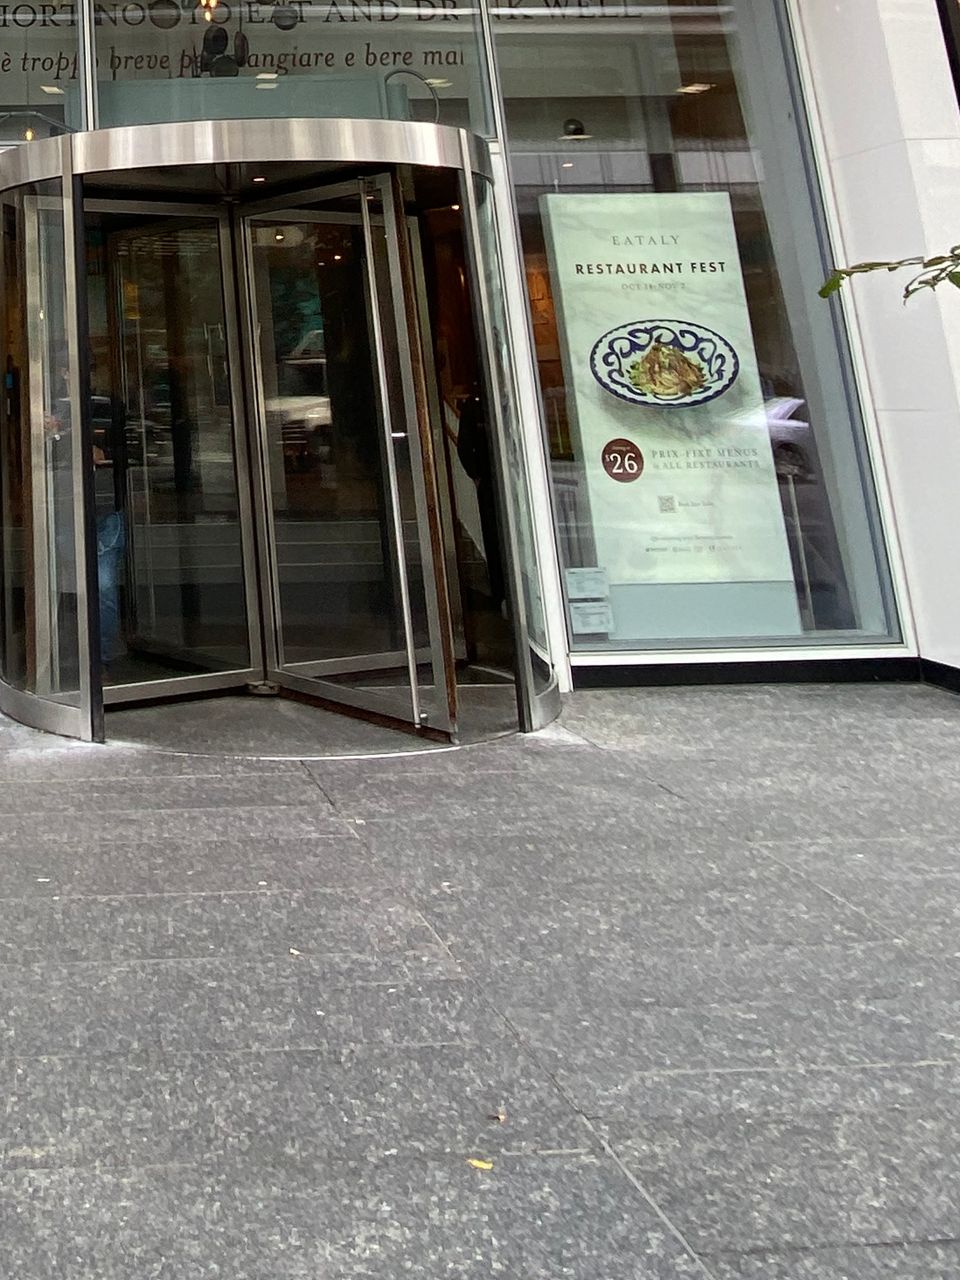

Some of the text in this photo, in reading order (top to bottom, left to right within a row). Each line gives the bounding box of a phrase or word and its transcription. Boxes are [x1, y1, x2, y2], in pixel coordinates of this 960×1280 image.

[245, 0, 313, 24] ET
[323, 0, 400, 24] AND
[1, 51, 12, 73] è
[110, 46, 170, 71] breve
[237, 46, 335, 75] angiare
[344, 52, 356, 68] e
[365, 42, 414, 68] bere
[611, 234, 681, 246] EATALY
[575, 261, 726, 275] RESTAURANT FEST
